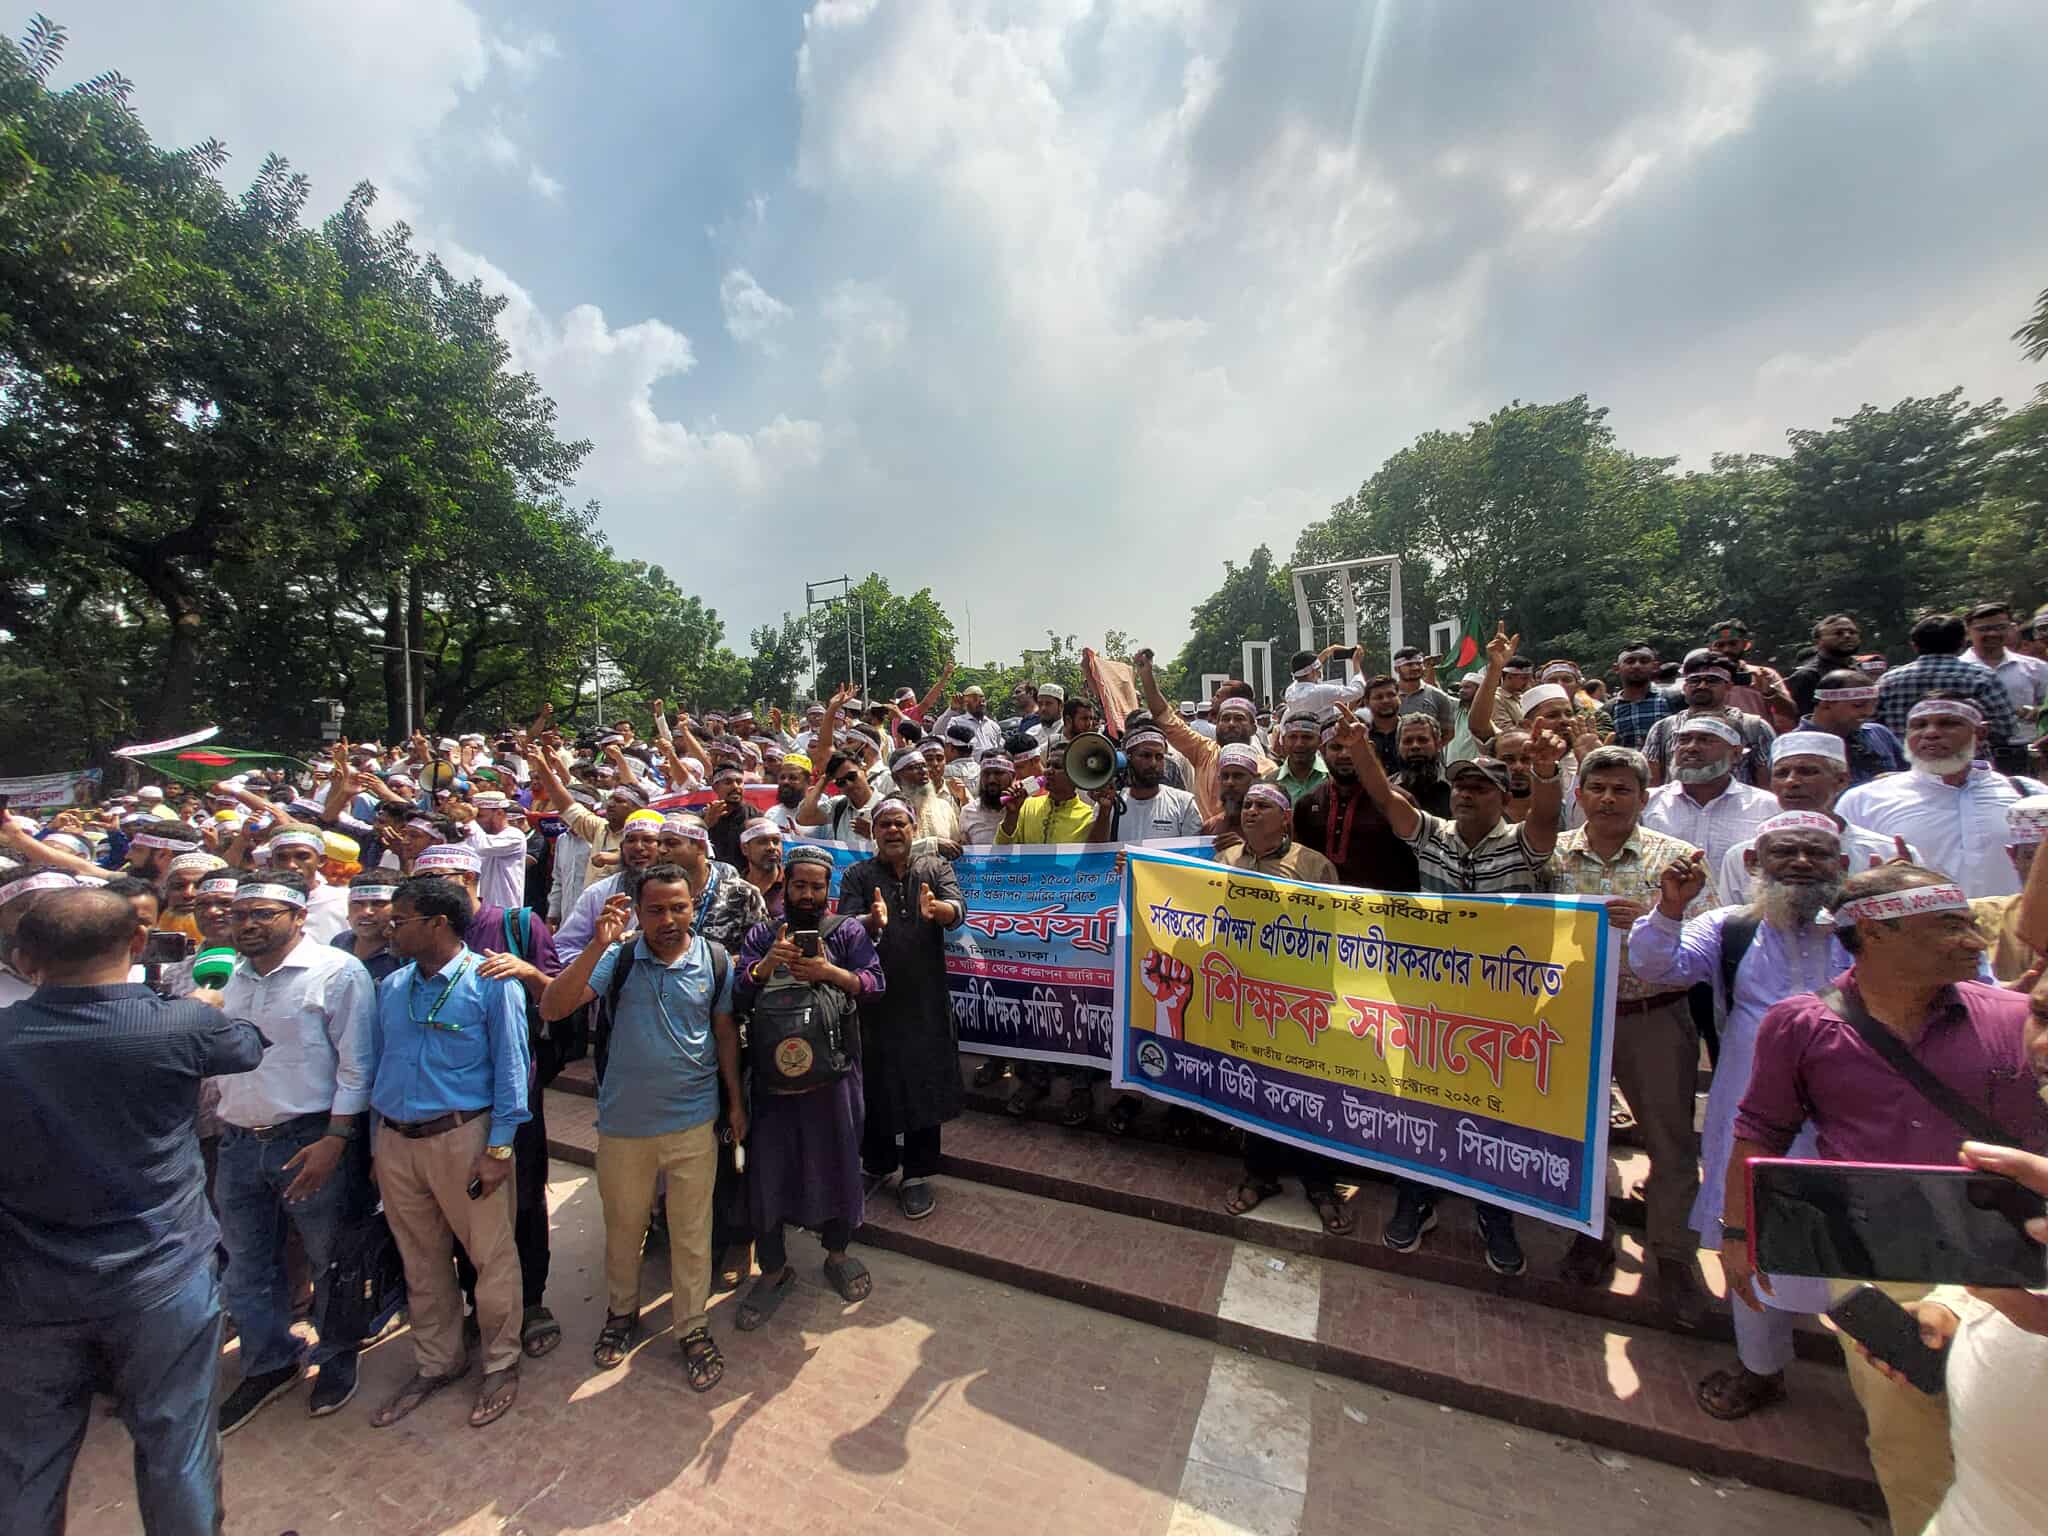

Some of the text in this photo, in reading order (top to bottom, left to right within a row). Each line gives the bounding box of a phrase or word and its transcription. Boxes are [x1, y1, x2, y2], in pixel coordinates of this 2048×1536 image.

[1227, 879, 1280, 904] বৈষম্য
[1287, 892, 1325, 911] নয়,
[1330, 892, 1363, 916] চাই
[1367, 896, 1452, 925] অধিকার
[1149, 896, 1566, 997] সর্বস্তরের শিক্ষা প্রতিষ্ঠান জাতীয়করণের দাবিতে
[1070, 990, 1114, 1056] শৈলকু
[1200, 951, 1564, 1095] শিক্ষক সমাবেশ
[1174, 1052, 1213, 1088] সলপ
[1218, 1058, 1257, 1104] ডিগ্রি
[1456, 1117, 1571, 1192] সিরাজগঞ্জ
[1370, 1072, 1387, 1087] ১২
[1444, 1087, 1481, 1107] ২০২৫
